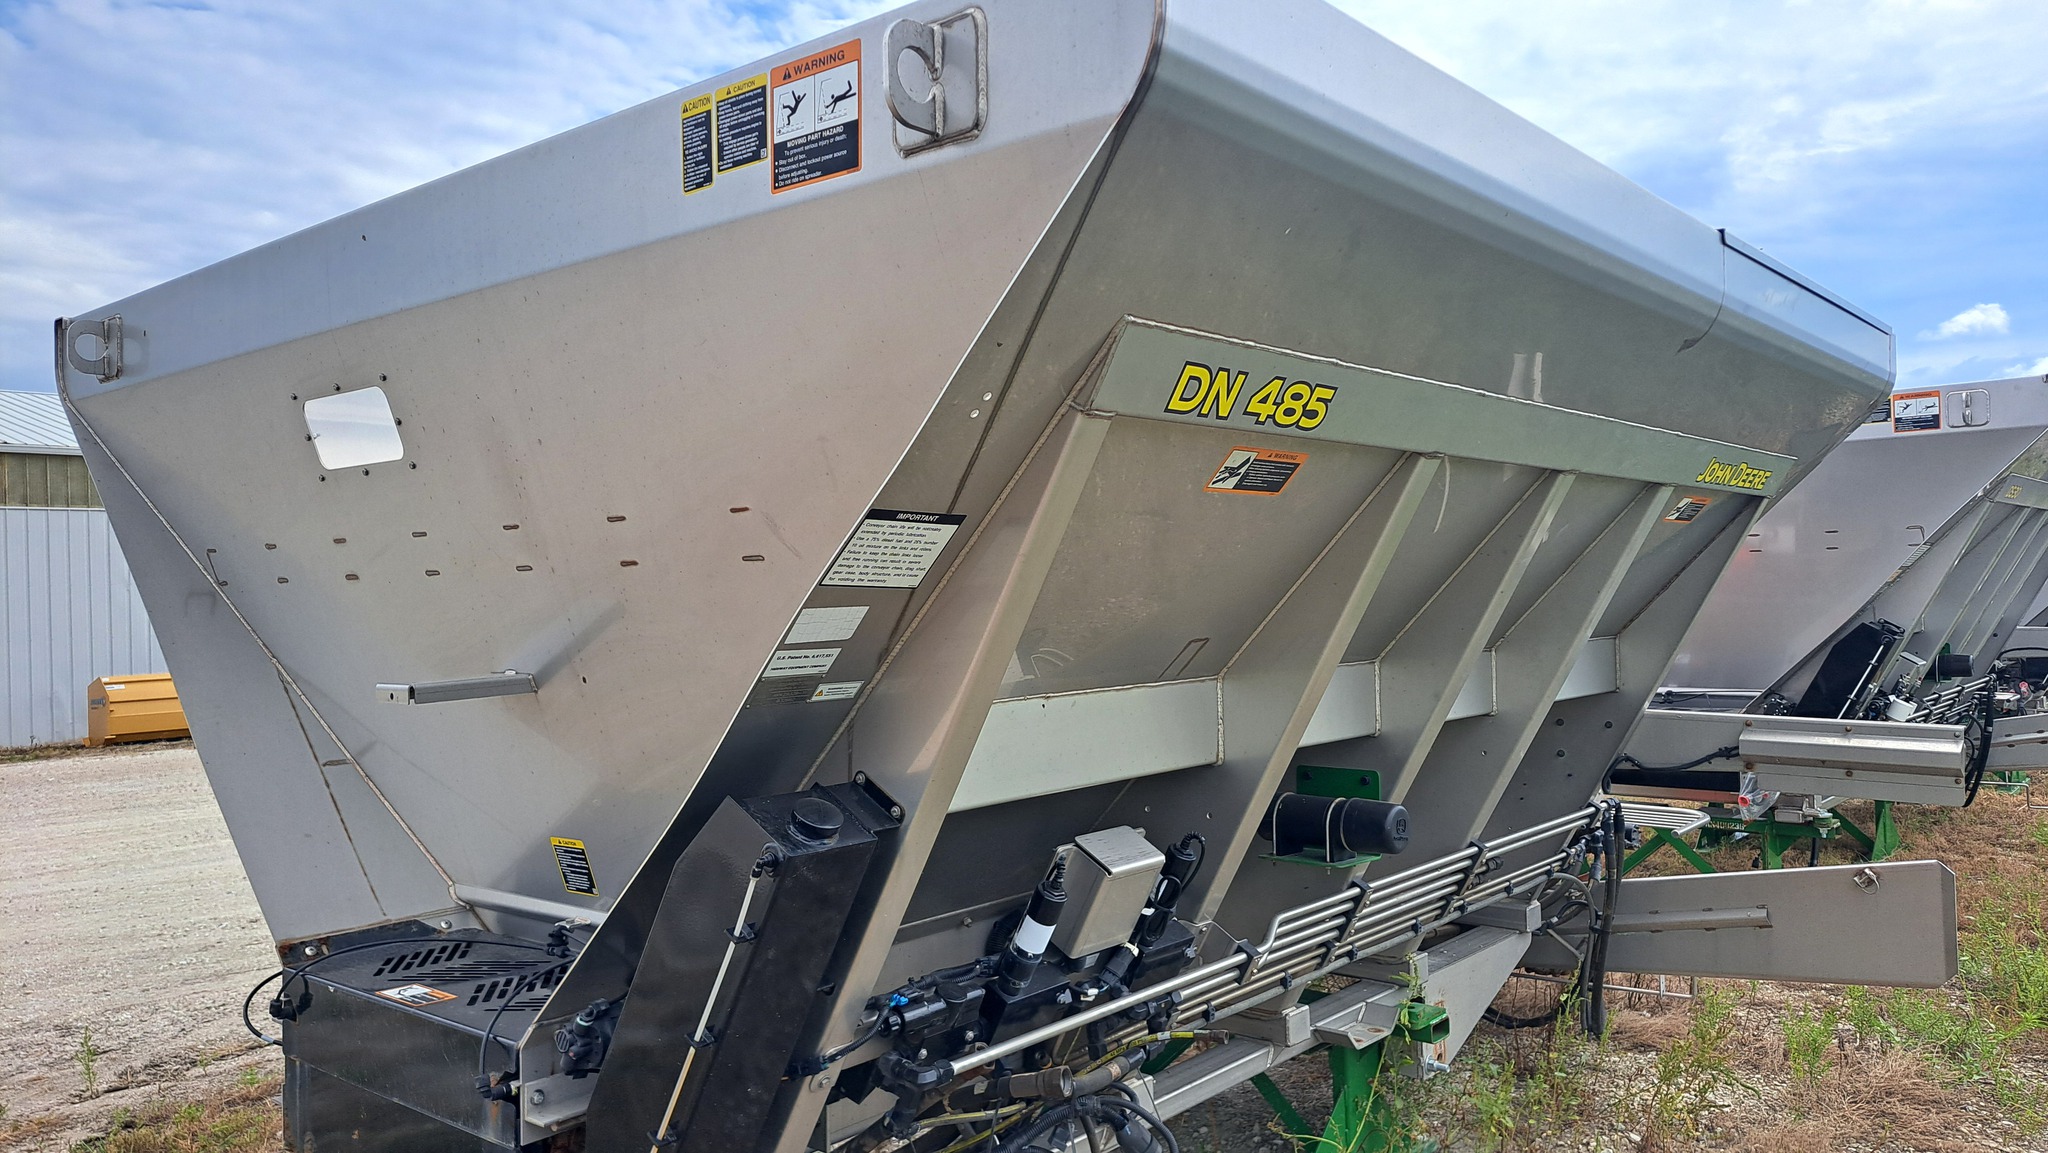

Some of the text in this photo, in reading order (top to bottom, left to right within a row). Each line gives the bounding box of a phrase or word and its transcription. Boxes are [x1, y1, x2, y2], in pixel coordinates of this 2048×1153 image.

[794, 50, 844, 75] WARNING
[733, 80, 755, 92] CAUTION
[689, 96, 710, 111] CAUTION
[787, 126, 843, 147] MOVING PART HAZARD
[821, 153, 833, 162] power
[1164, 361, 1339, 431] DN 485
[1696, 457, 1773, 490] JOHN DEERE
[896, 513, 940, 521] IMPORTANT
